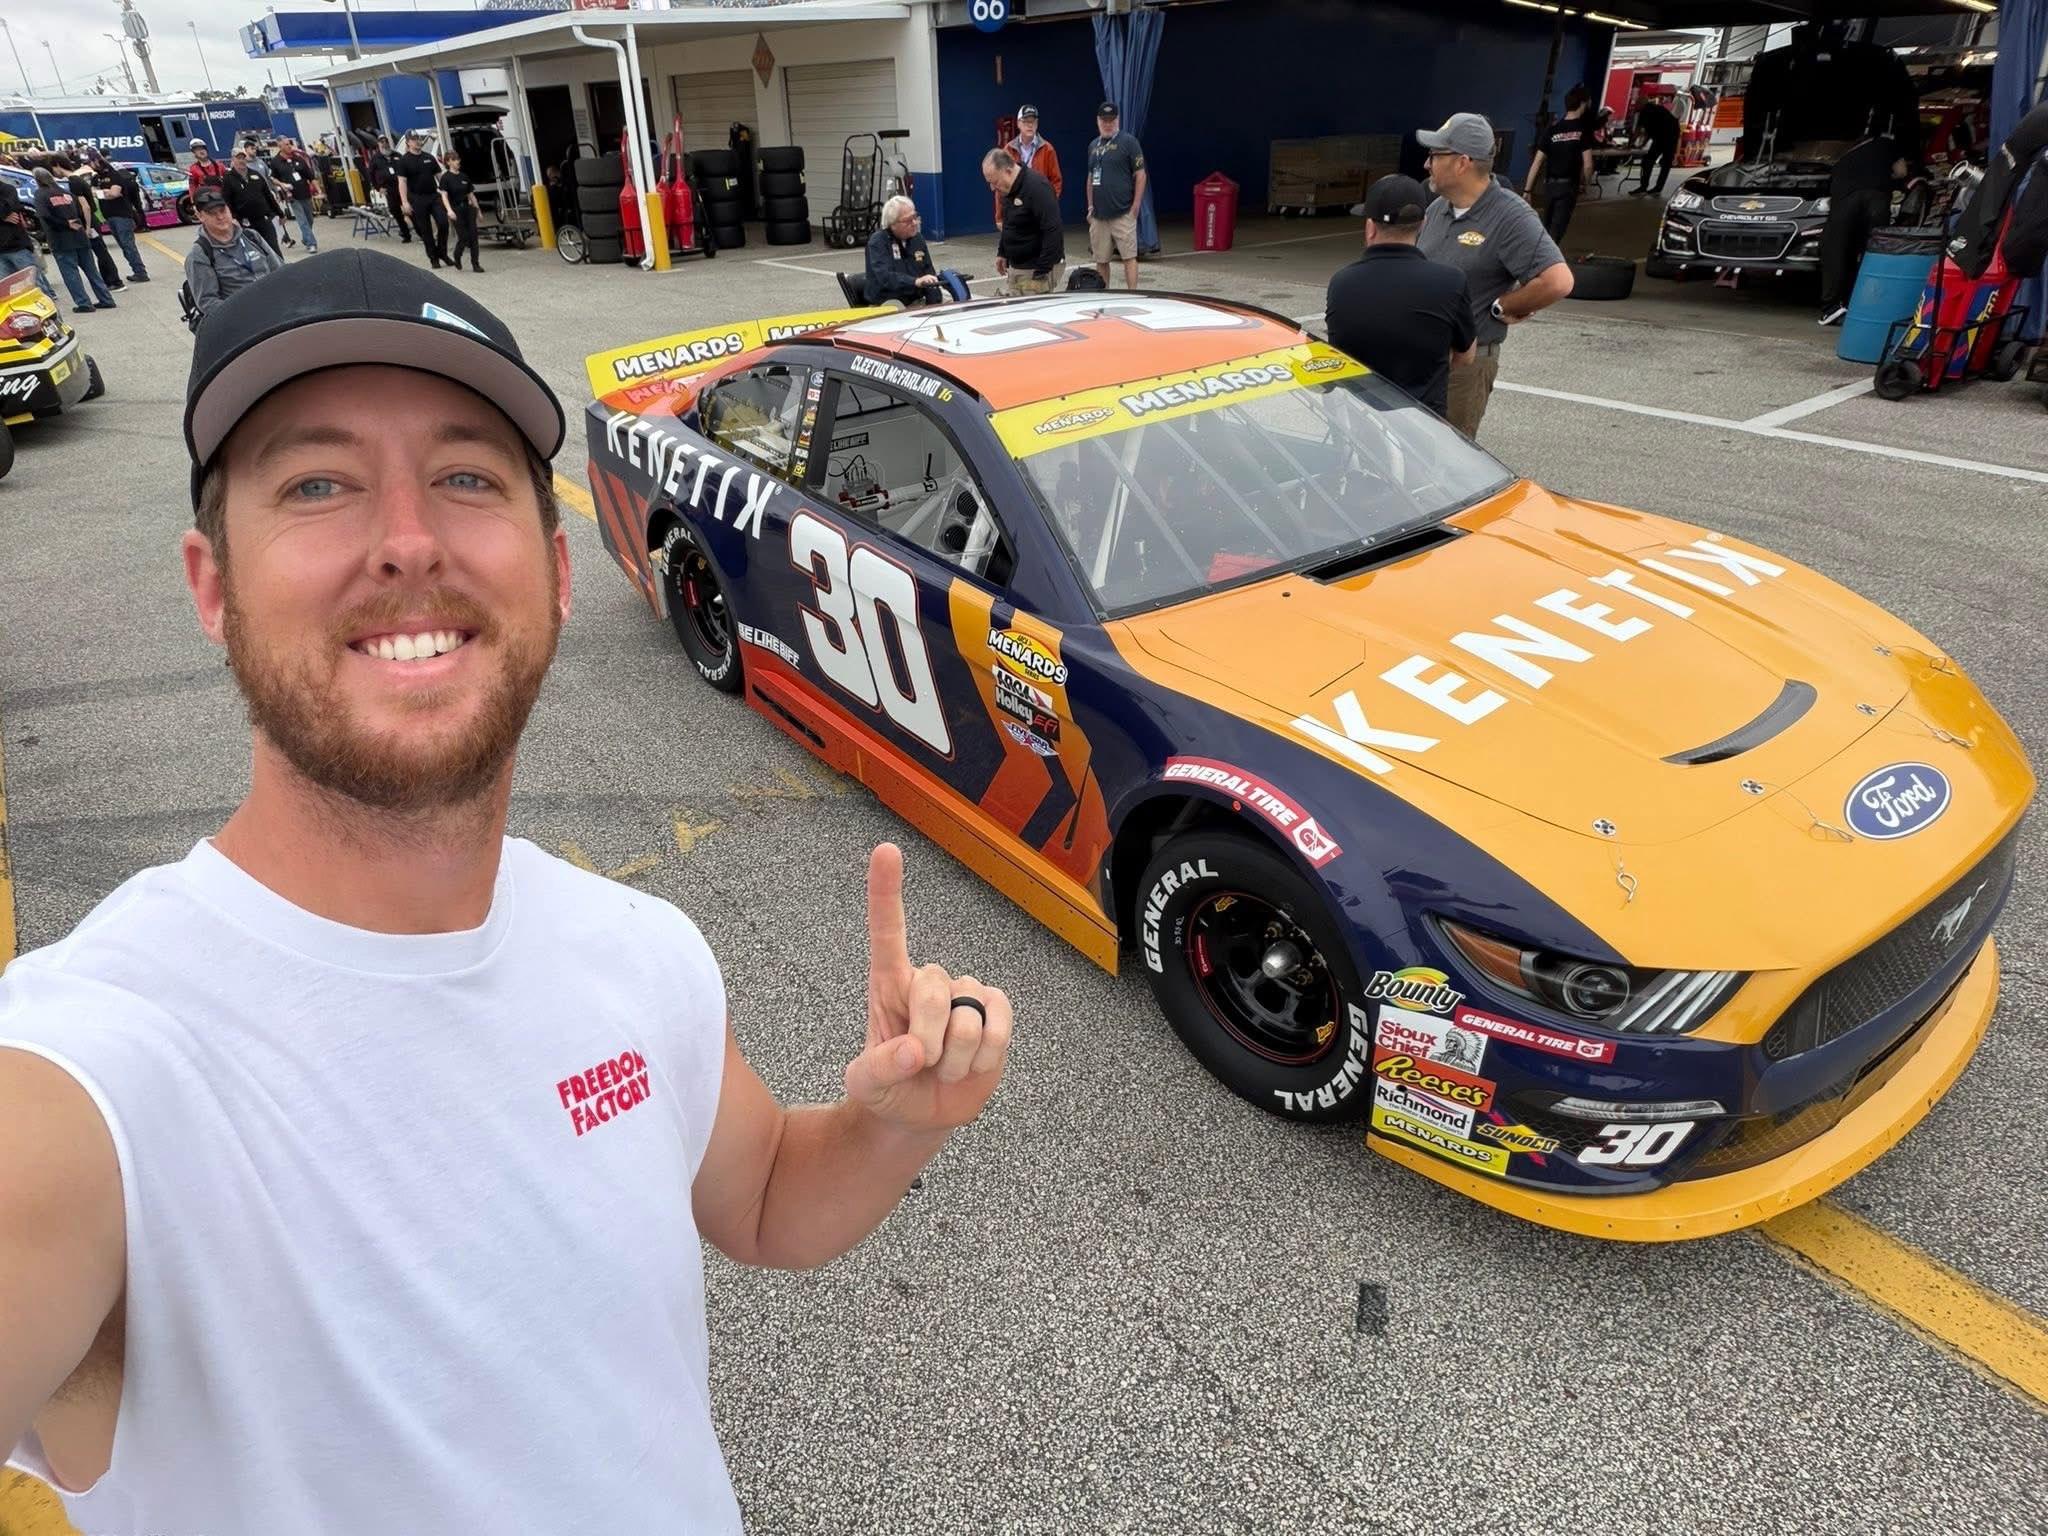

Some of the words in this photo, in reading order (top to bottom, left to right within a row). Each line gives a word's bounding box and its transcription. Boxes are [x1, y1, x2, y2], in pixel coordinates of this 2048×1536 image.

[973, 0, 1005, 21] 66
[99, 135, 144, 149] FUELS
[614, 332, 744, 381] MENARDS
[850, 354, 889, 380] CLEETUS
[937, 387, 954, 402] 16
[1118, 362, 1295, 418] MENARDS
[1033, 407, 1115, 435] MENARDS
[606, 410, 777, 540] KENETIX
[789, 512, 952, 756] 30
[988, 629, 1067, 685] MENARDS
[1288, 539, 1787, 776] KENETIX
[995, 686, 1034, 726] Holley
[1164, 763, 1251, 796] GENERAL
[1247, 786, 1299, 827] TIRE
[1861, 773, 1937, 828] Ford
[1142, 858, 1219, 974] GENERAL
[1364, 970, 1461, 1013] Bounty
[1378, 1033, 1430, 1058] Chief
[1380, 1021, 1438, 1046] Sioux
[1461, 1013, 1535, 1043] GENERAL
[1535, 1034, 1577, 1052] TIRE
[556, 1047, 647, 1110] FREEDOM
[1274, 1002, 1368, 1112] GENERAL
[1375, 1055, 1490, 1107] Reese's
[570, 1071, 651, 1137] FACTORY
[1377, 1084, 1468, 1130] Richmond
[1384, 1115, 1493, 1163] MENARDS
[1476, 1123, 1560, 1154] SUNOCO
[1577, 1121, 1695, 1165] 30
